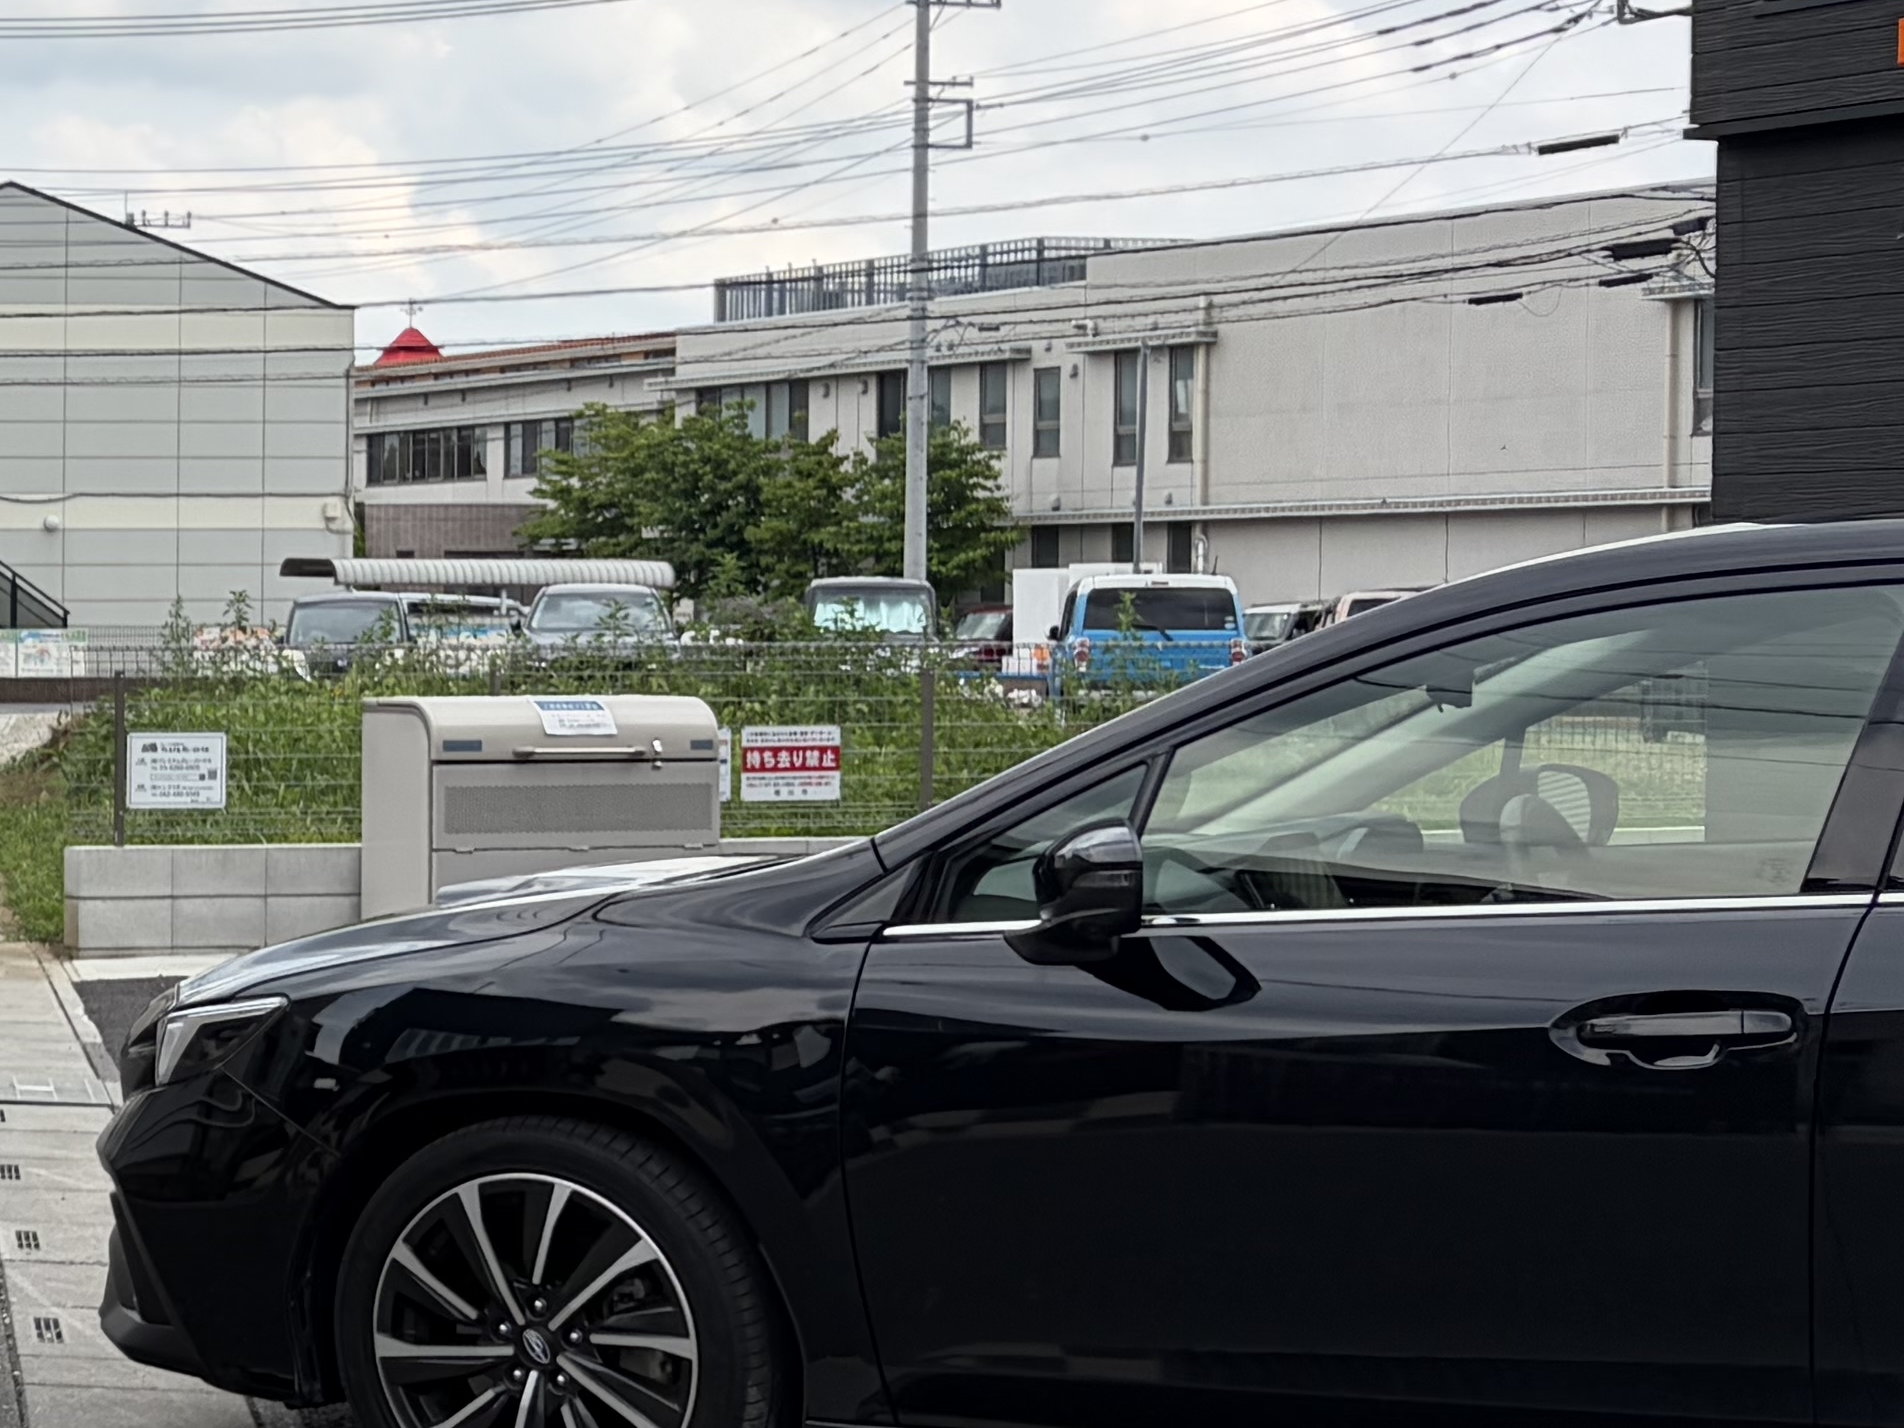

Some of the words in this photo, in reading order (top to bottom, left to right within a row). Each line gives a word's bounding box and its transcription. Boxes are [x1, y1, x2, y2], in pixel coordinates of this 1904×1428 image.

[746, 749, 836, 769] 持ち去り禁止
